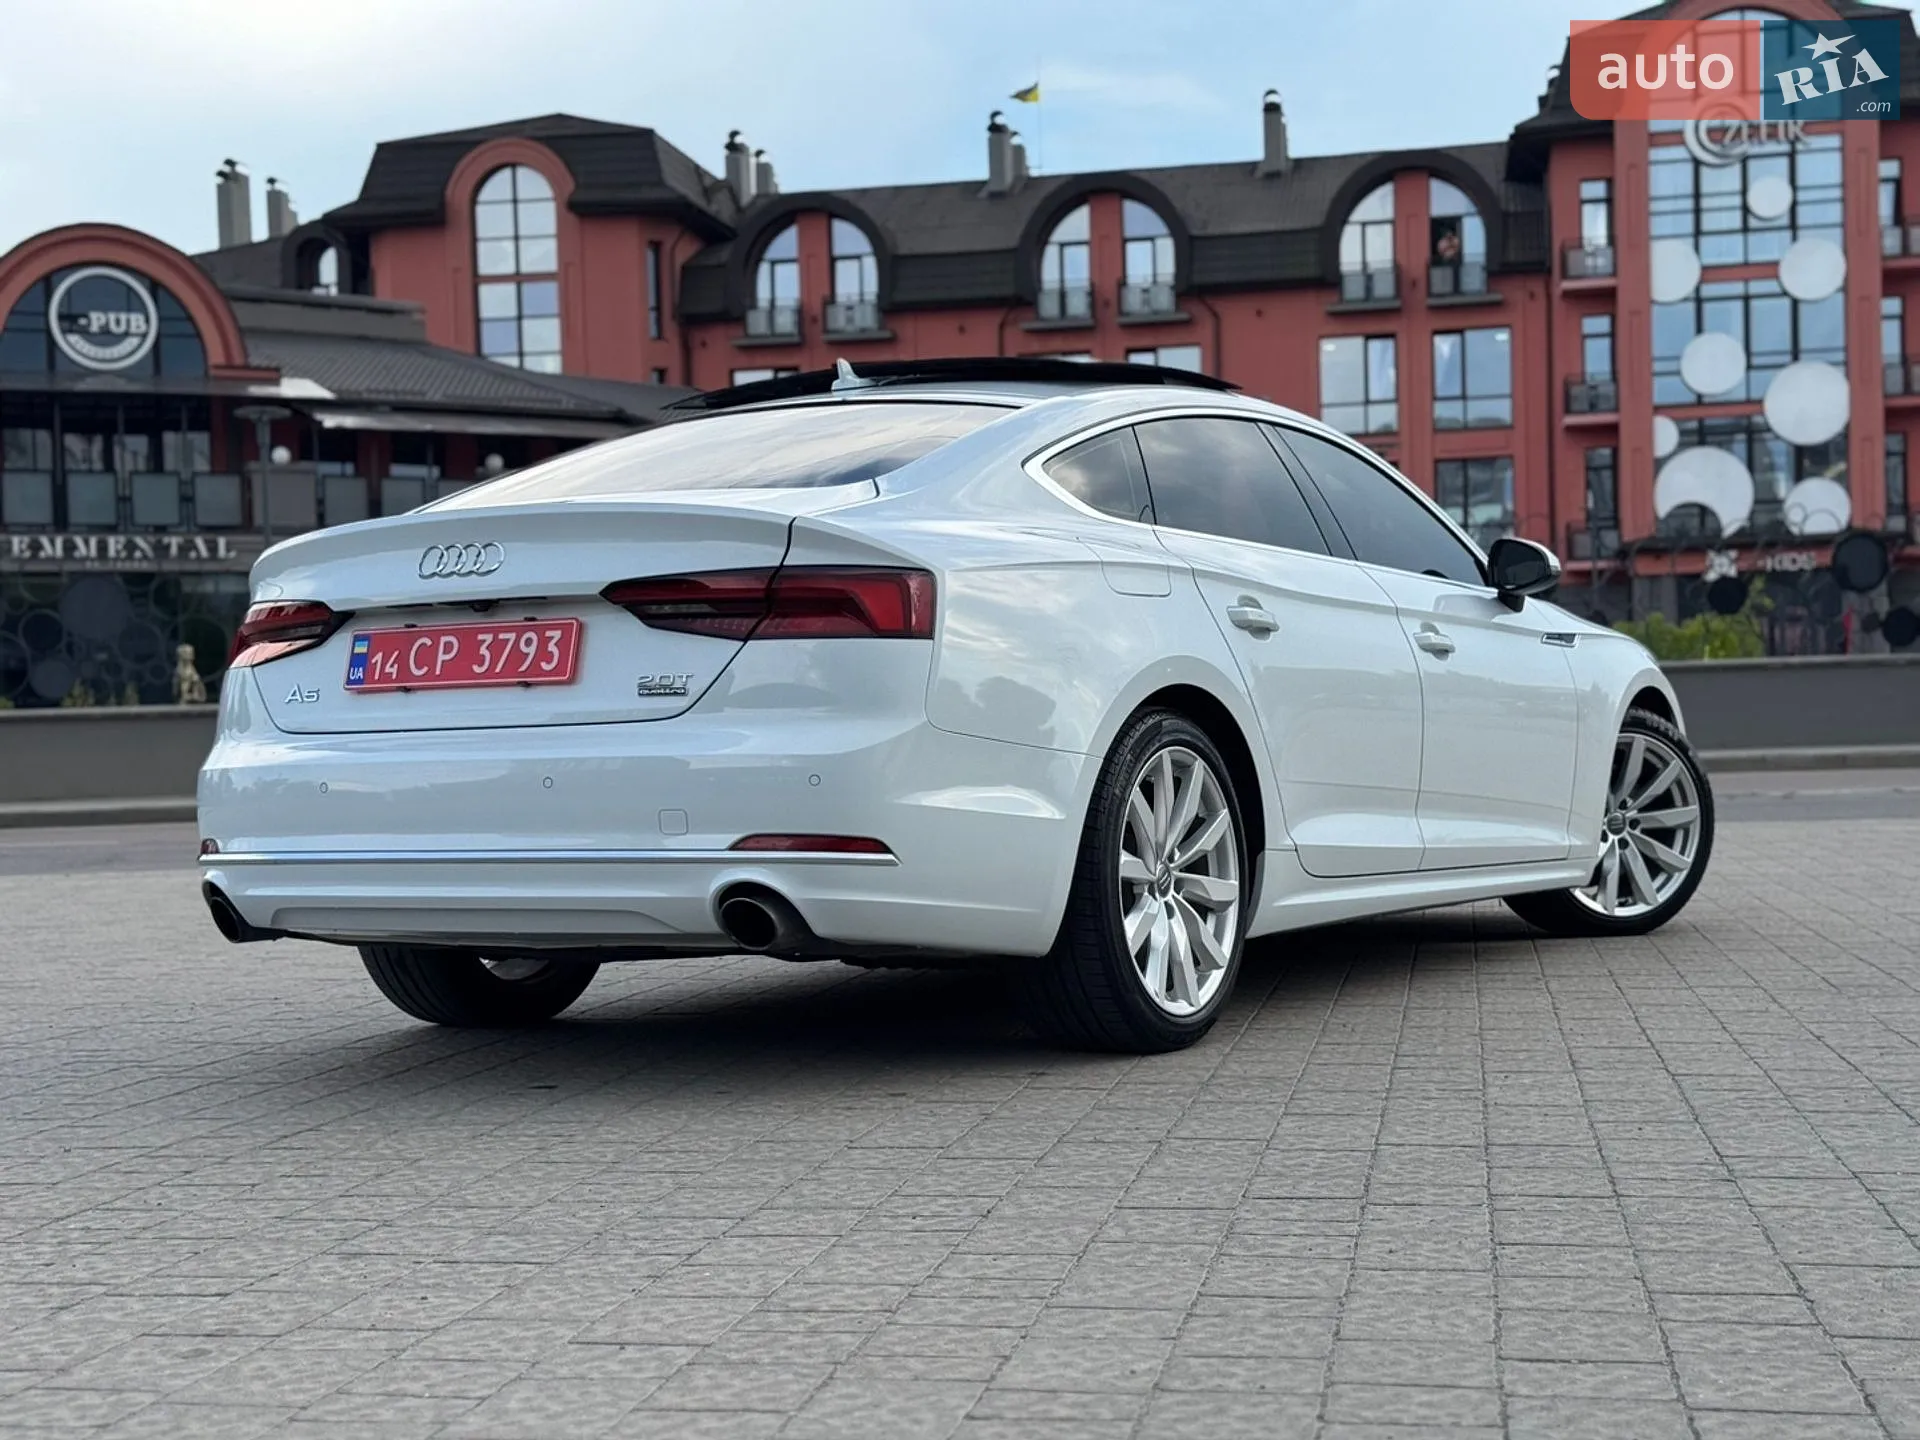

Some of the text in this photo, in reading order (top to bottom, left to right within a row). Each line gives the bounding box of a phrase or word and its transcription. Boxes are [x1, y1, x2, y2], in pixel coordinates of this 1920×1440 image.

[10, 534, 238, 560] EMMENTAL
[371, 629, 563, 680] 14 CP 3793
[349, 666, 364, 680] UA
[284, 683, 320, 704] A5
